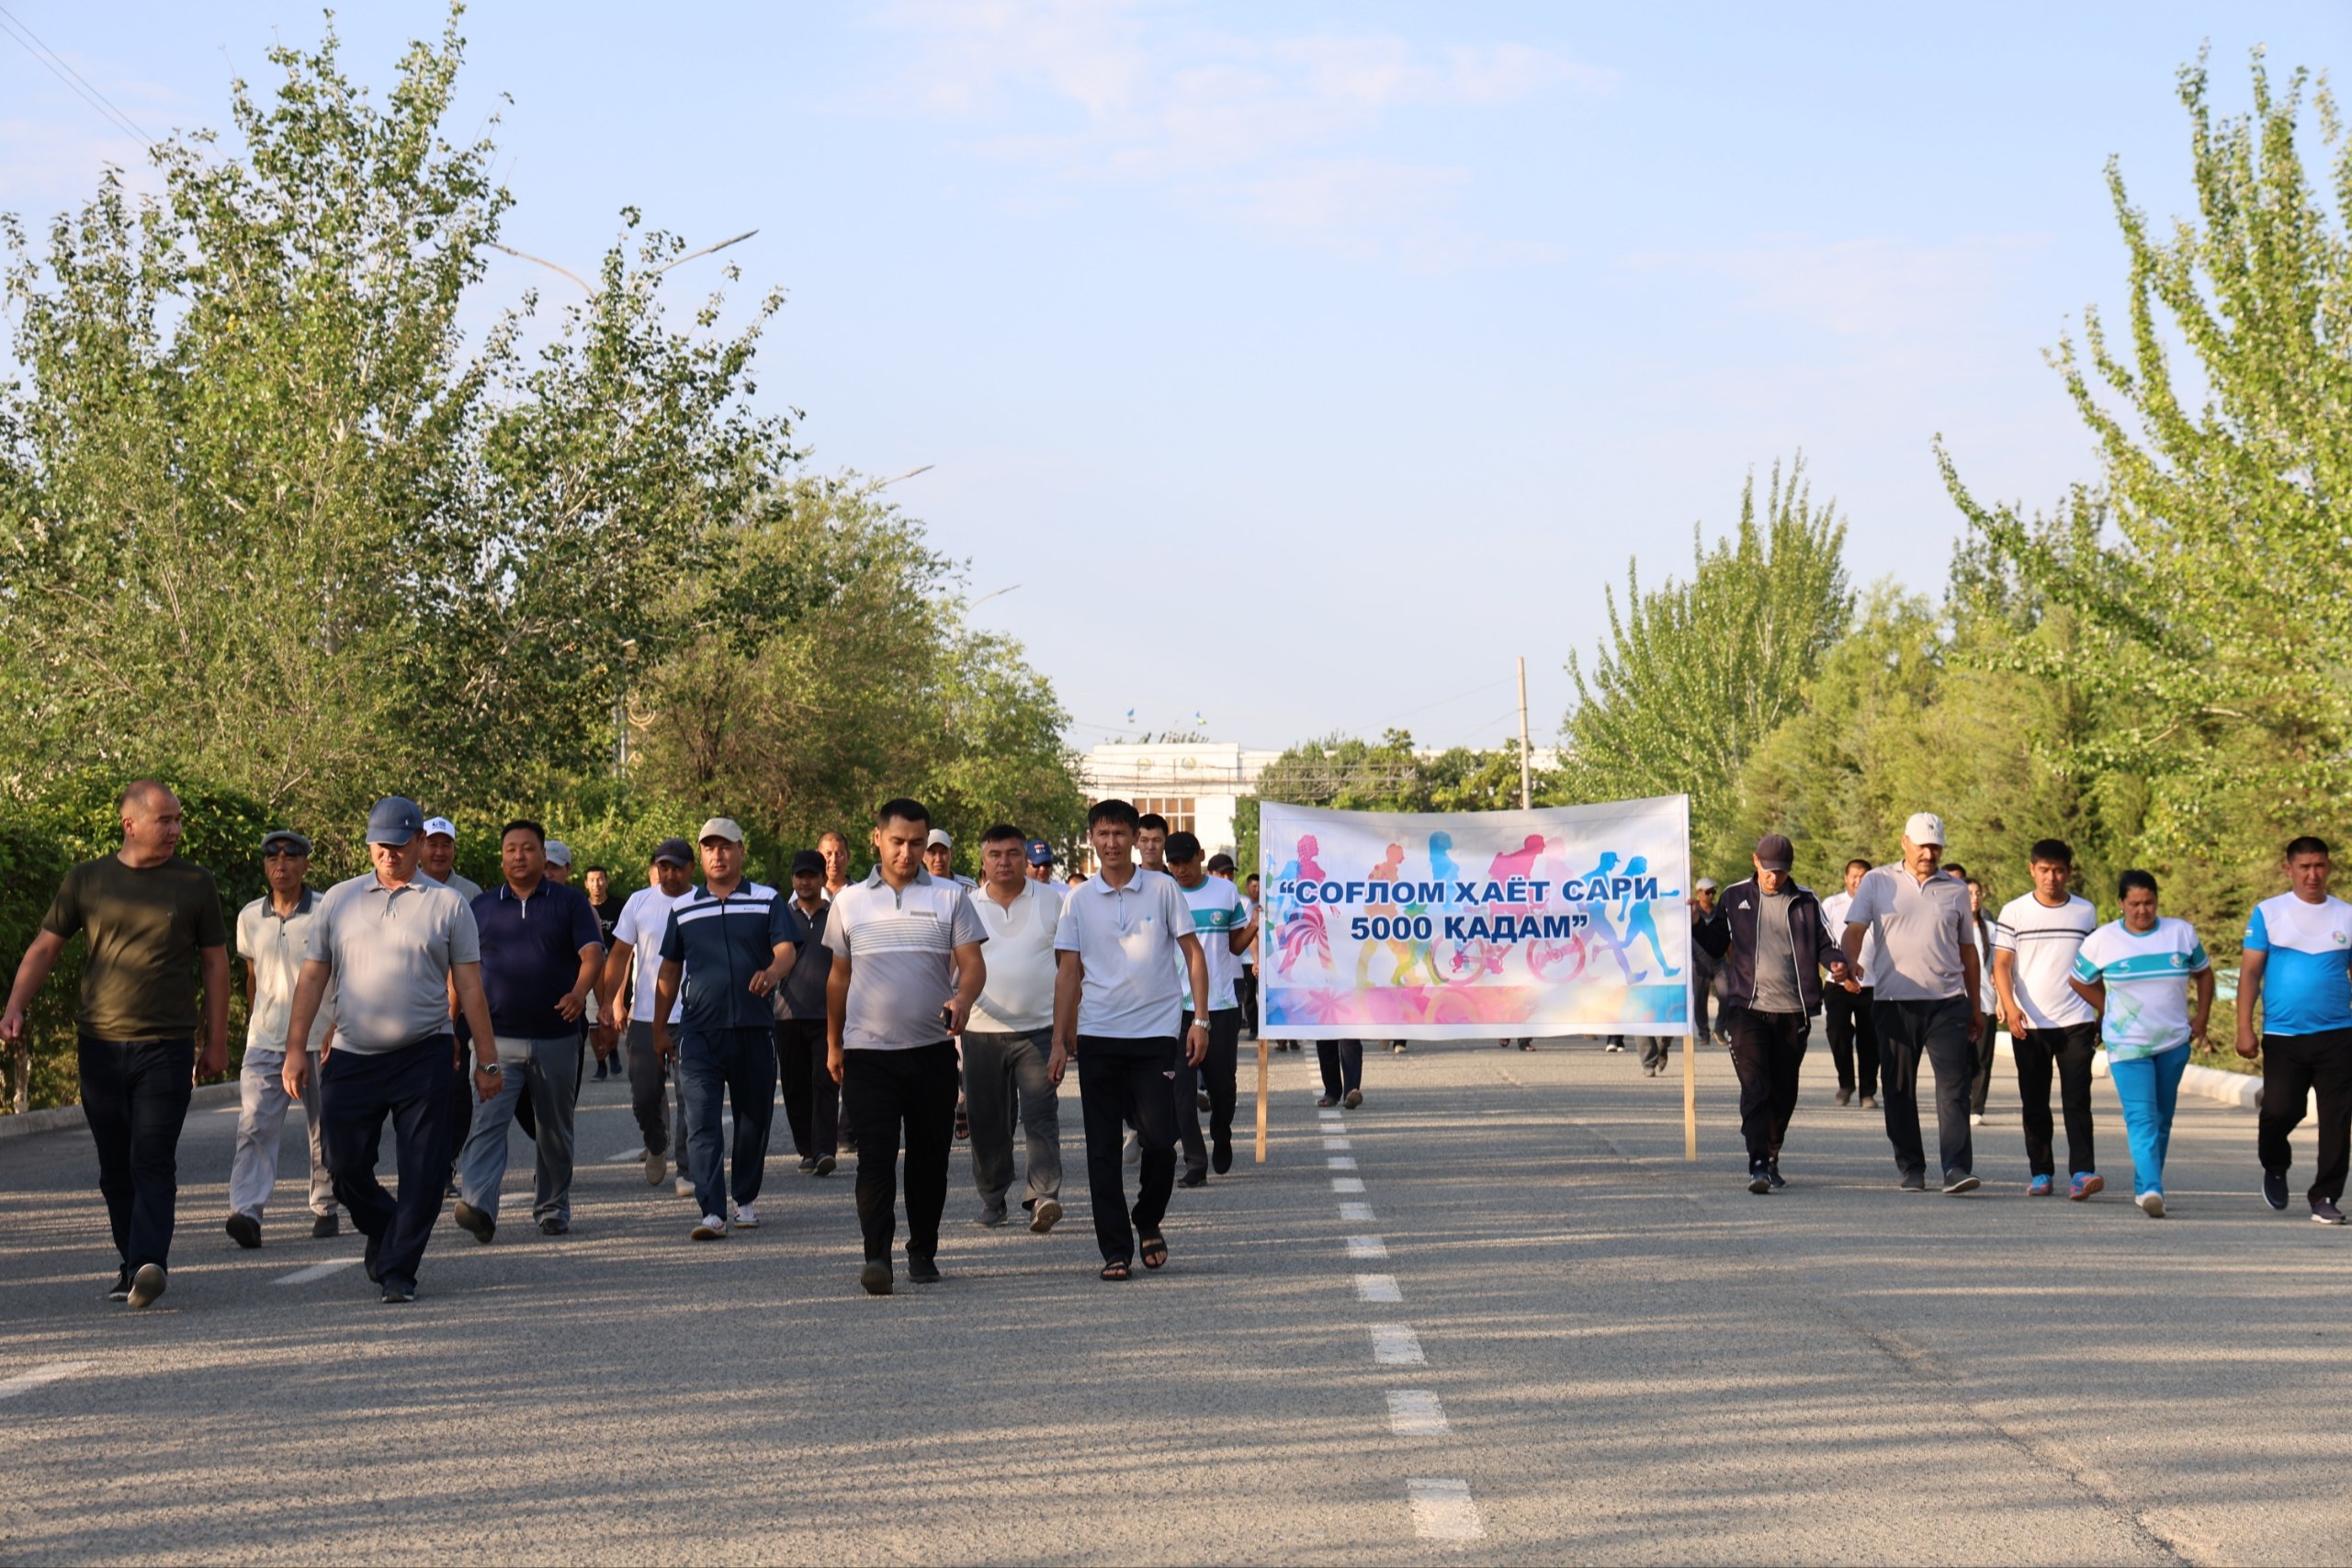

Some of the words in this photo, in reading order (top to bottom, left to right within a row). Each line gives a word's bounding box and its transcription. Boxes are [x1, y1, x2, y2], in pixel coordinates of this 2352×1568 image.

[1454, 876, 1551, 906] ҲАЁТ
[1562, 876, 1658, 901] САРИ
[1351, 916, 1432, 941] 5000
[1445, 915, 1588, 943] ҚАДАМ”
